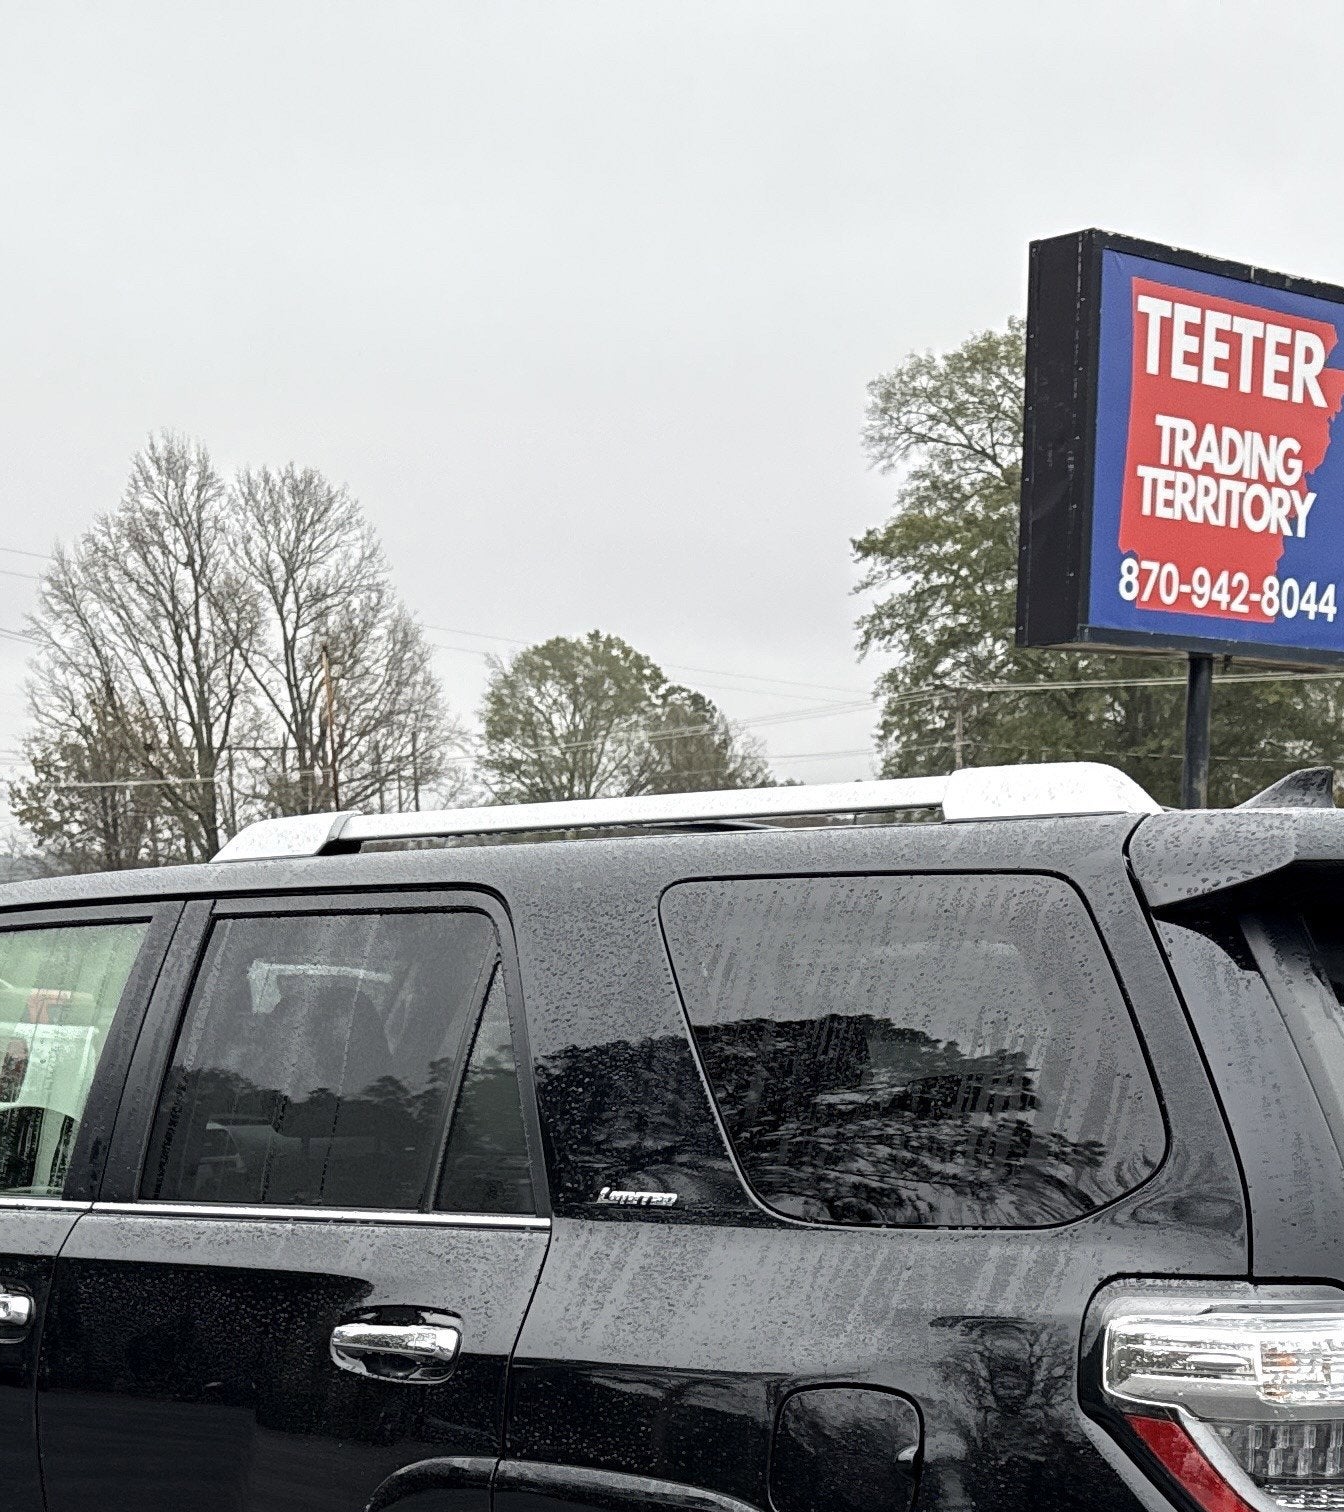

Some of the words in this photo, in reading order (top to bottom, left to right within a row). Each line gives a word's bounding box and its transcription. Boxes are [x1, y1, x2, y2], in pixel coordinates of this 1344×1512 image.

[1138, 294, 1328, 408] TEETER
[1155, 414, 1303, 486] TRADING
[1136, 464, 1317, 538] TERRITORY
[1119, 557, 1337, 622] 870-942-8044
